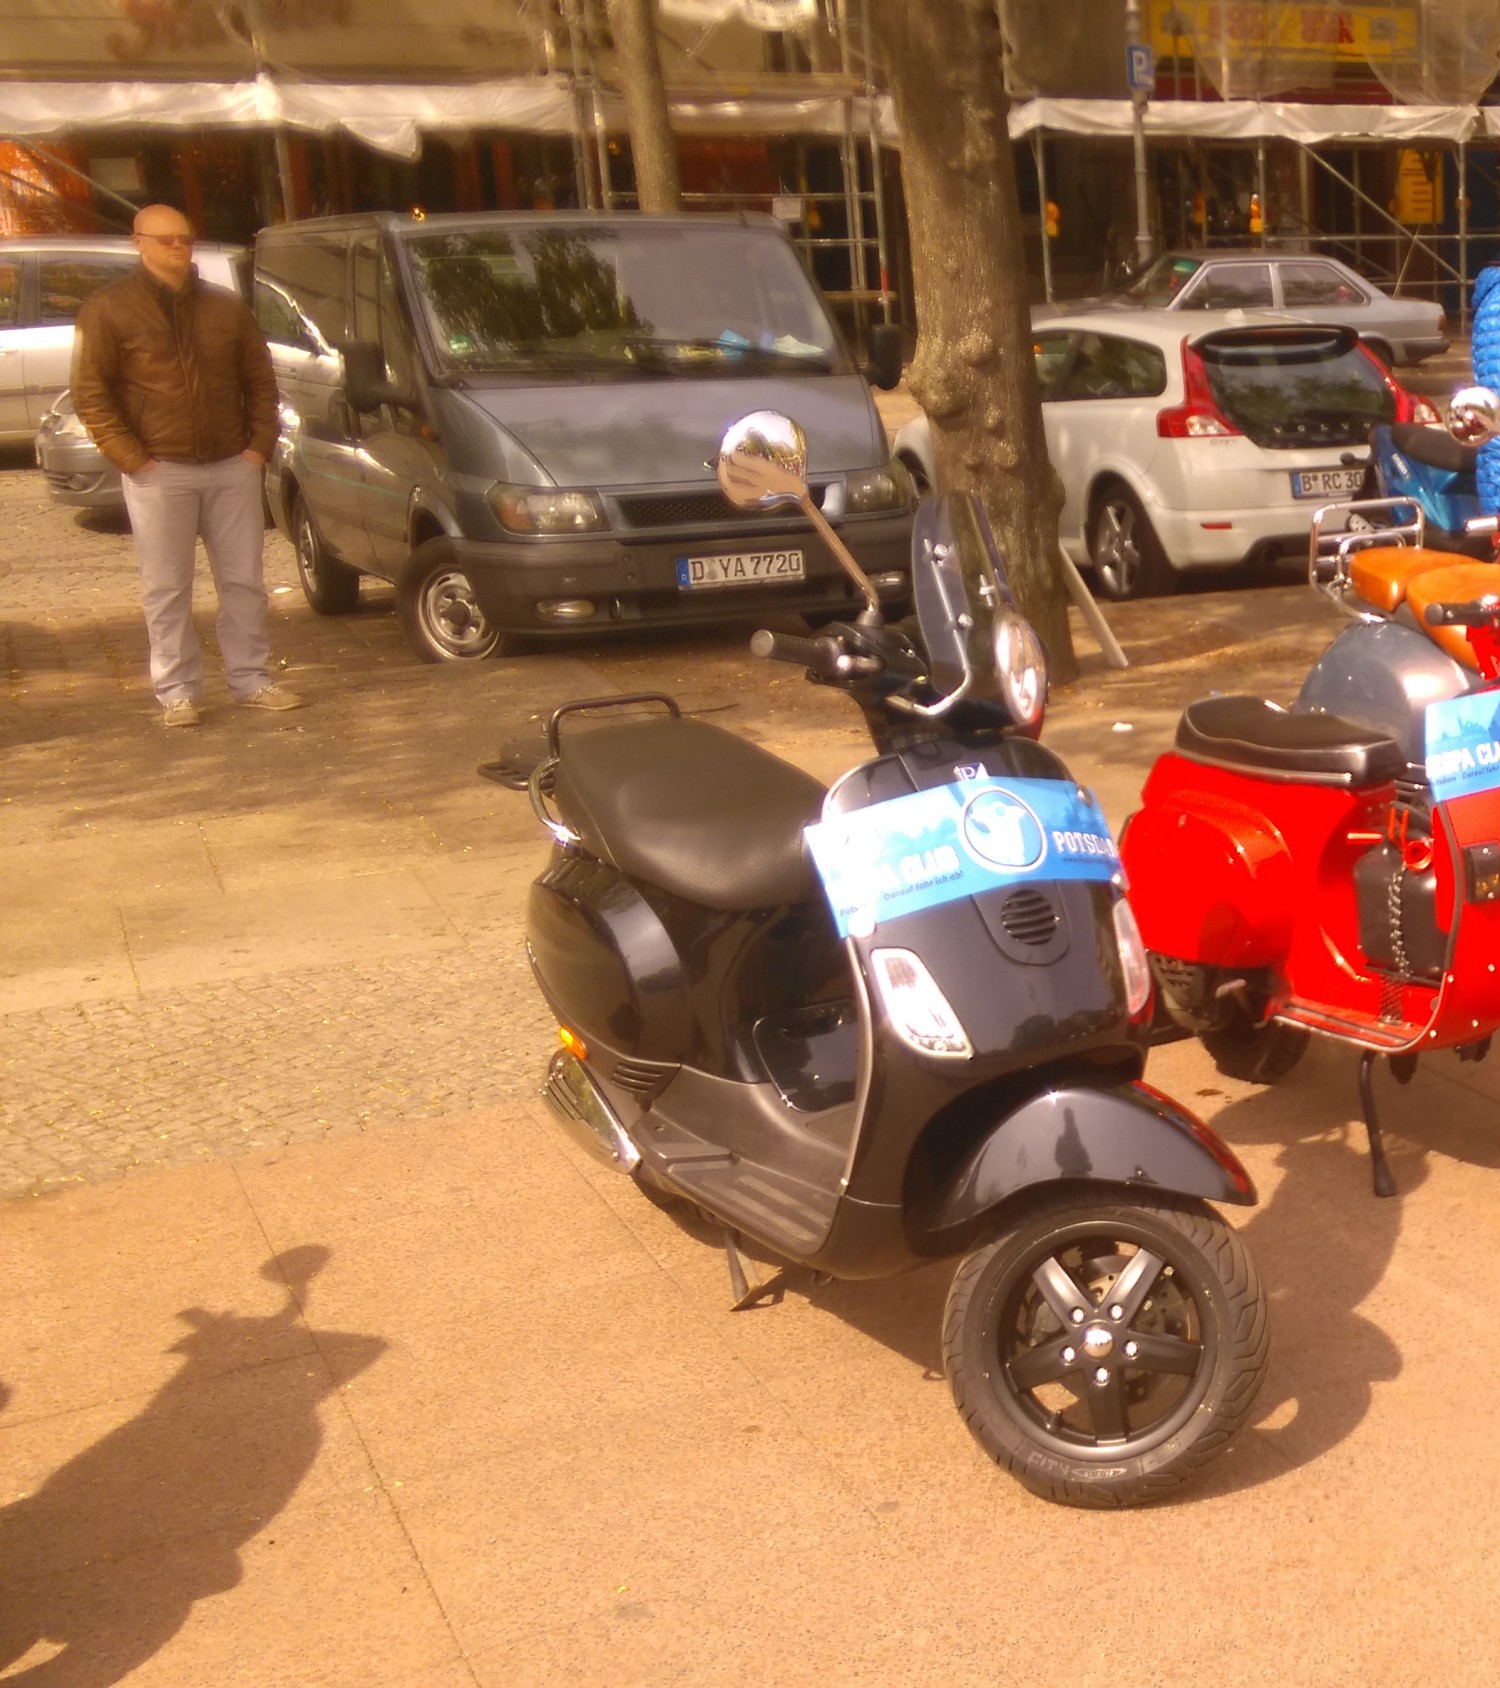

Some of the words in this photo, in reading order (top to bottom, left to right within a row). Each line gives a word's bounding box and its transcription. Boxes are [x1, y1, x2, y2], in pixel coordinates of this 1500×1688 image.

[1272, 421, 1371, 435] VOLVO
[1302, 474, 1312, 492] B
[1323, 472, 1342, 490] RC
[691, 560, 705, 581] D
[719, 557, 746, 578] YA
[750, 552, 801, 575] 7720
[914, 878, 934, 892] fahr
[935, 875, 948, 885] ich
